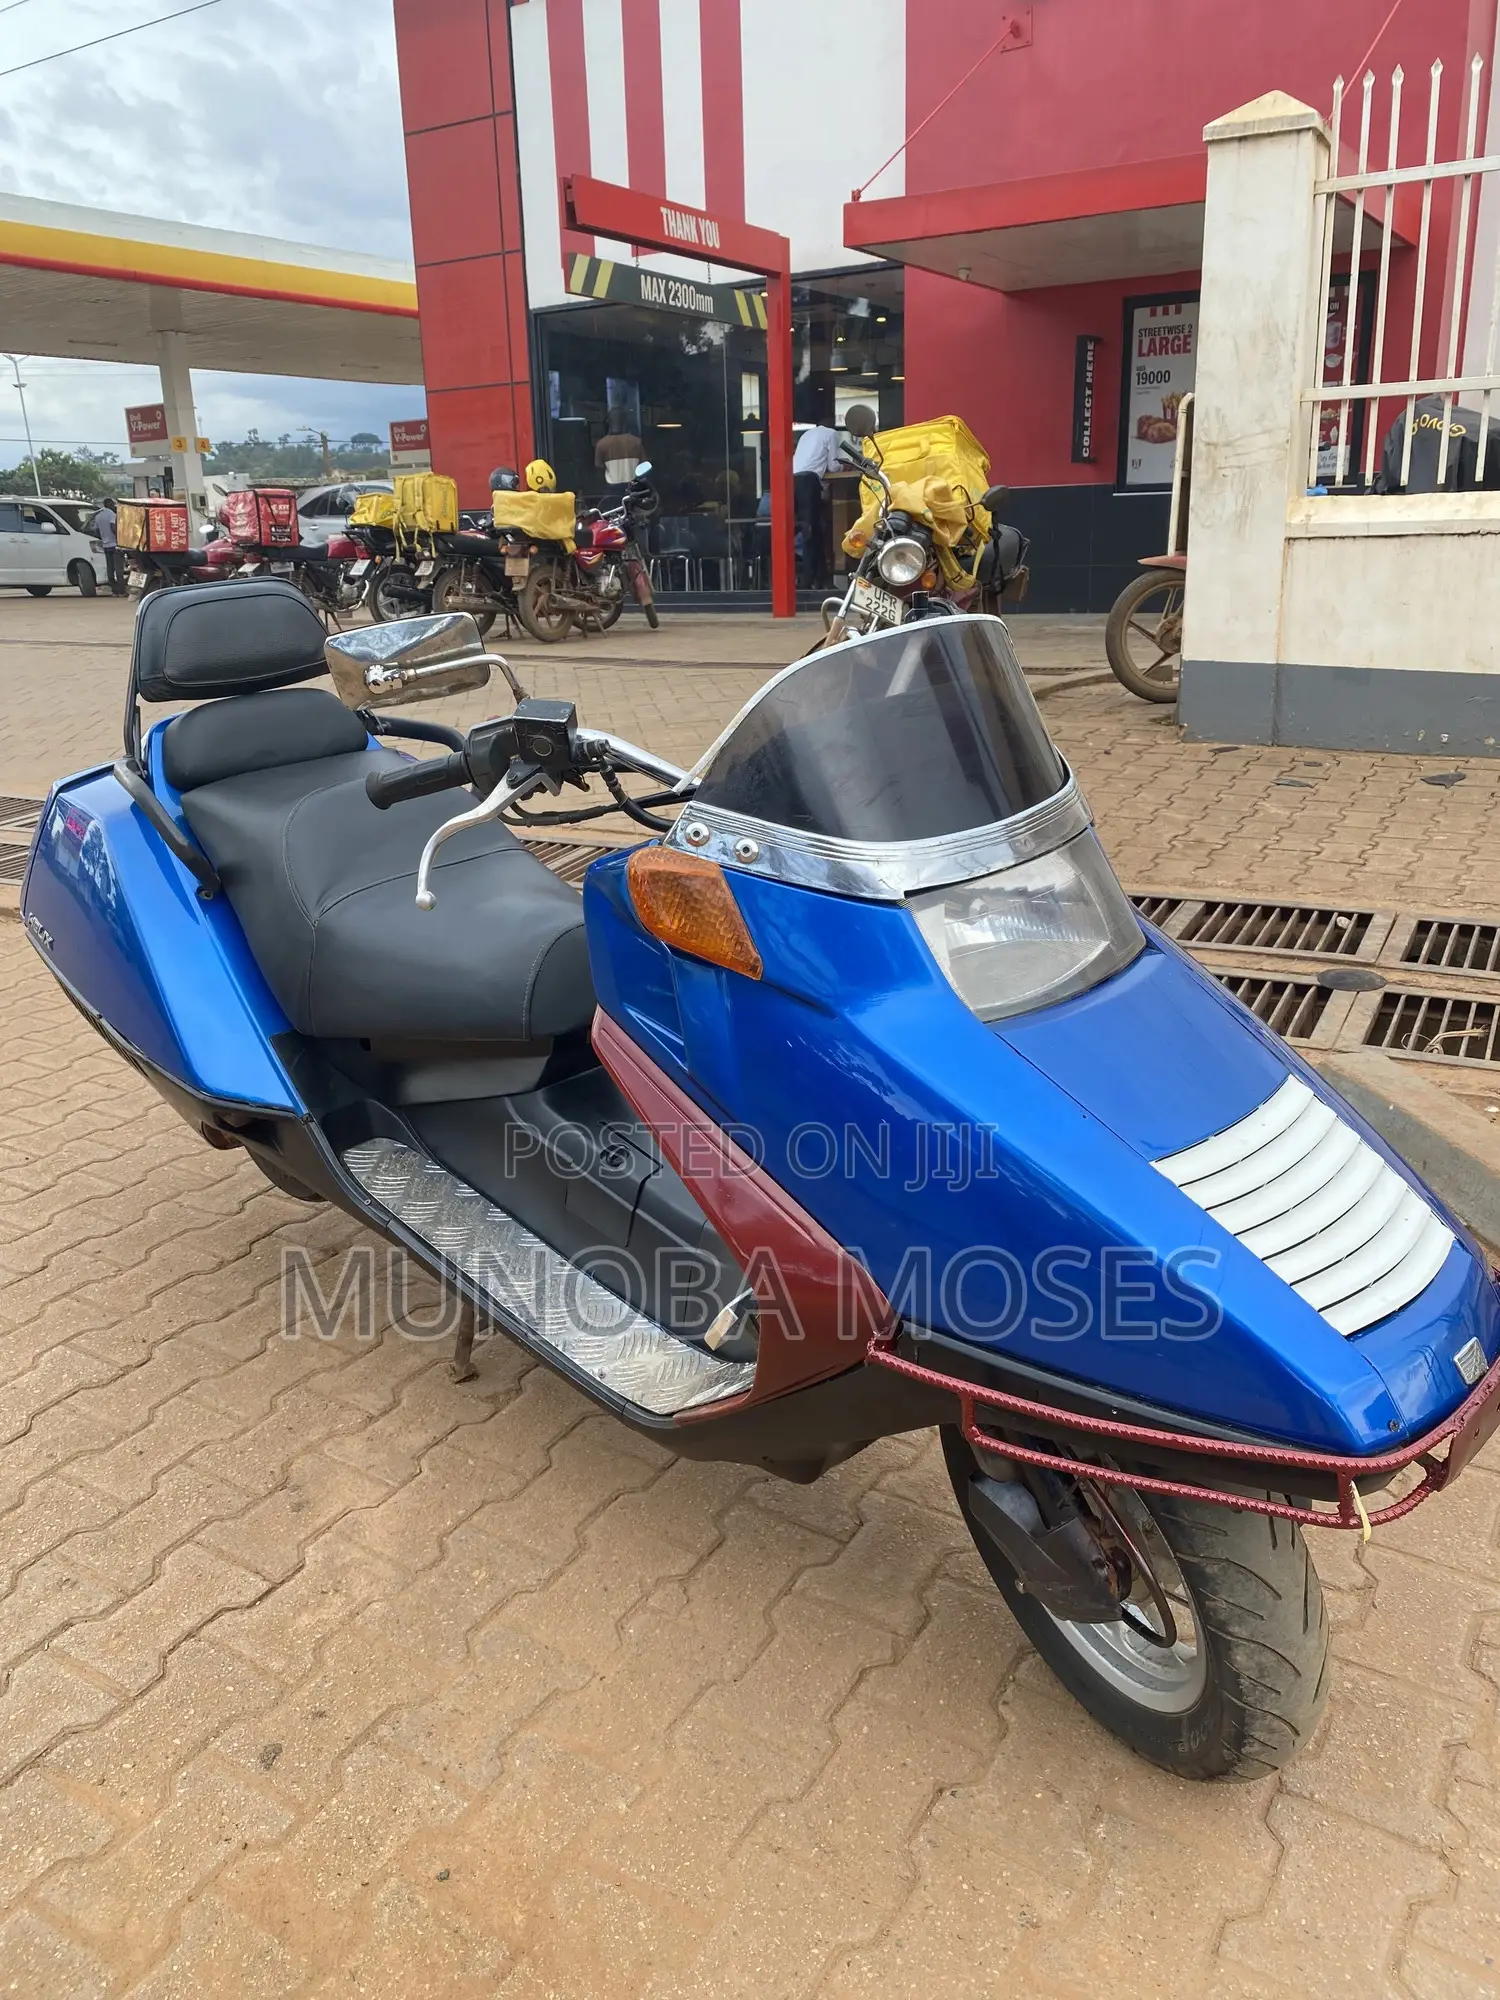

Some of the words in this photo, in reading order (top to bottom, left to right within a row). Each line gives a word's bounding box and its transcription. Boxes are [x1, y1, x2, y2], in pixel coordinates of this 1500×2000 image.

[660, 206, 699, 245] THANK
[698, 217, 721, 249] YOU
[640, 274, 667, 305] MAX
[668, 280, 714, 314] 2300mm
[1138, 325, 1185, 338] STREETWISE
[1187, 323, 1193, 333] 2
[1137, 334, 1192, 358] LARGE
[1085, 340, 1096, 383] HERE
[1136, 370, 1171, 385] 19000
[130, 420, 161, 432] V-Power
[1082, 385, 1093, 458] COLLECT
[176, 439, 183, 448] 3
[394, 432, 425, 442] V-Power
[170, 512, 179, 528] HOT
[179, 516, 187, 536] EASY
[874, 587, 897, 610] UFR
[865, 597, 896, 622] 222G
